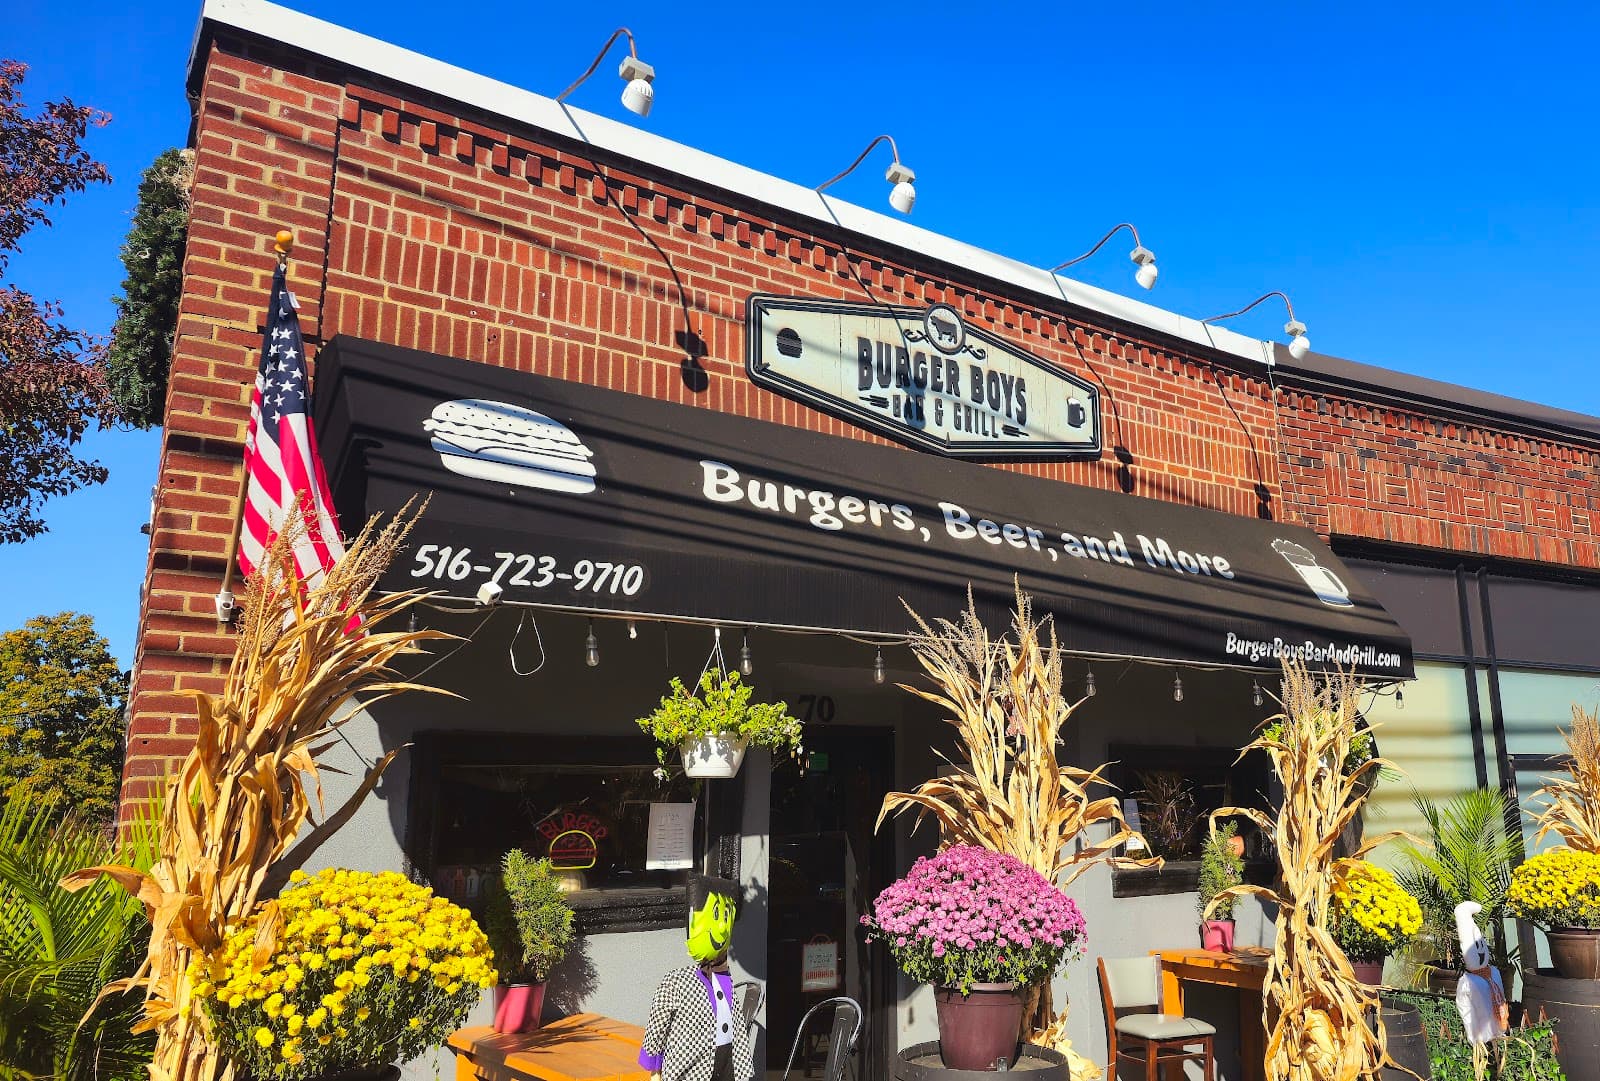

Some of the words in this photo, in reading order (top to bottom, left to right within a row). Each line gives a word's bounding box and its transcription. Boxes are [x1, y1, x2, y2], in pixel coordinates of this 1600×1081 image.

[857, 336, 960, 397] BURGER
[969, 364, 1027, 427] BOYS
[892, 394, 925, 423] BAR
[934, 398, 944, 427] &
[953, 403, 999, 438] GRILL
[700, 460, 931, 542] Burgers,
[937, 501, 1058, 562] Beer,
[1062, 531, 1134, 566] and
[1136, 534, 1235, 579] More
[411, 544, 644, 596] 516-723-9710
[1226, 632, 1401, 668] BurgerBoysBarAndGrill.com
[798, 694, 835, 722] 70
[539, 811, 609, 841] BURGER
